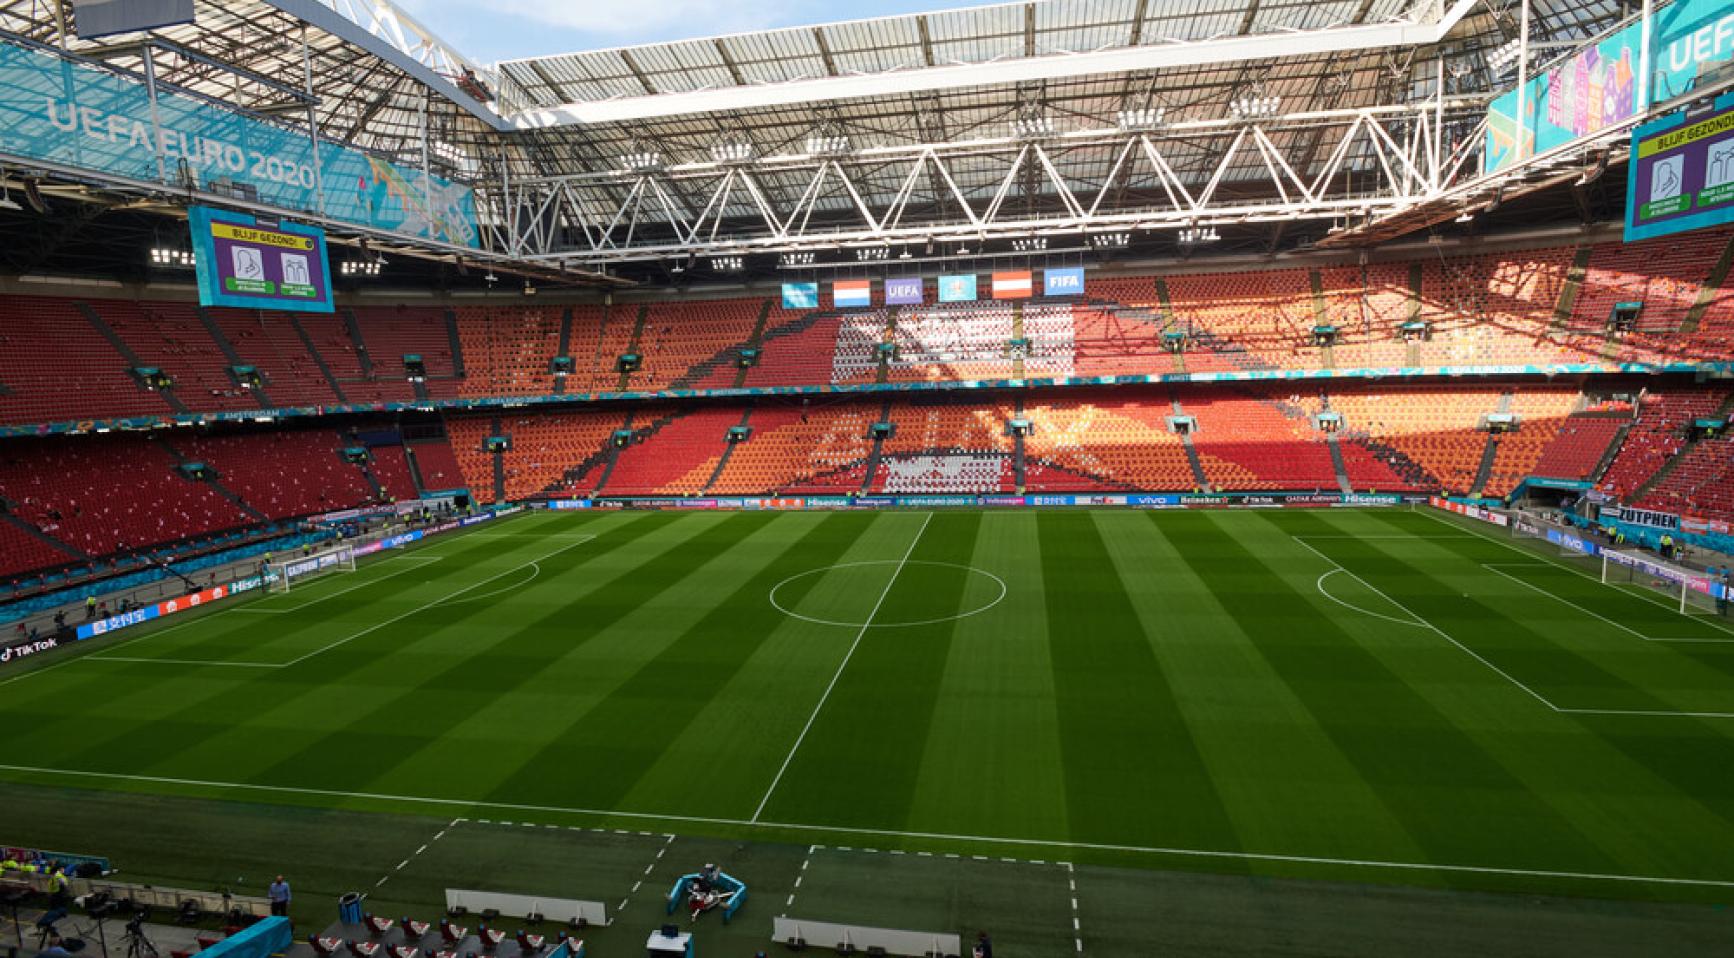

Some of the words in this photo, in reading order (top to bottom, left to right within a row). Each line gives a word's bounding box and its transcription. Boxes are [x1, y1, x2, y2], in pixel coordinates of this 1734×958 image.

[1669, 13, 1734, 72] UEF
[48, 98, 152, 150] UEFA
[158, 127, 246, 172] EURO
[252, 151, 316, 189] 2020
[1657, 134, 1684, 150] BLIJF
[232, 228, 257, 239] BLIJF
[1050, 275, 1079, 287] FIFA
[888, 286, 919, 297] UEFA
[1138, 497, 1168, 505] vivo
[1345, 494, 1397, 504] Hisense
[1619, 509, 1676, 528] ZUTPHEN
[15, 638, 57, 658] TikTok
